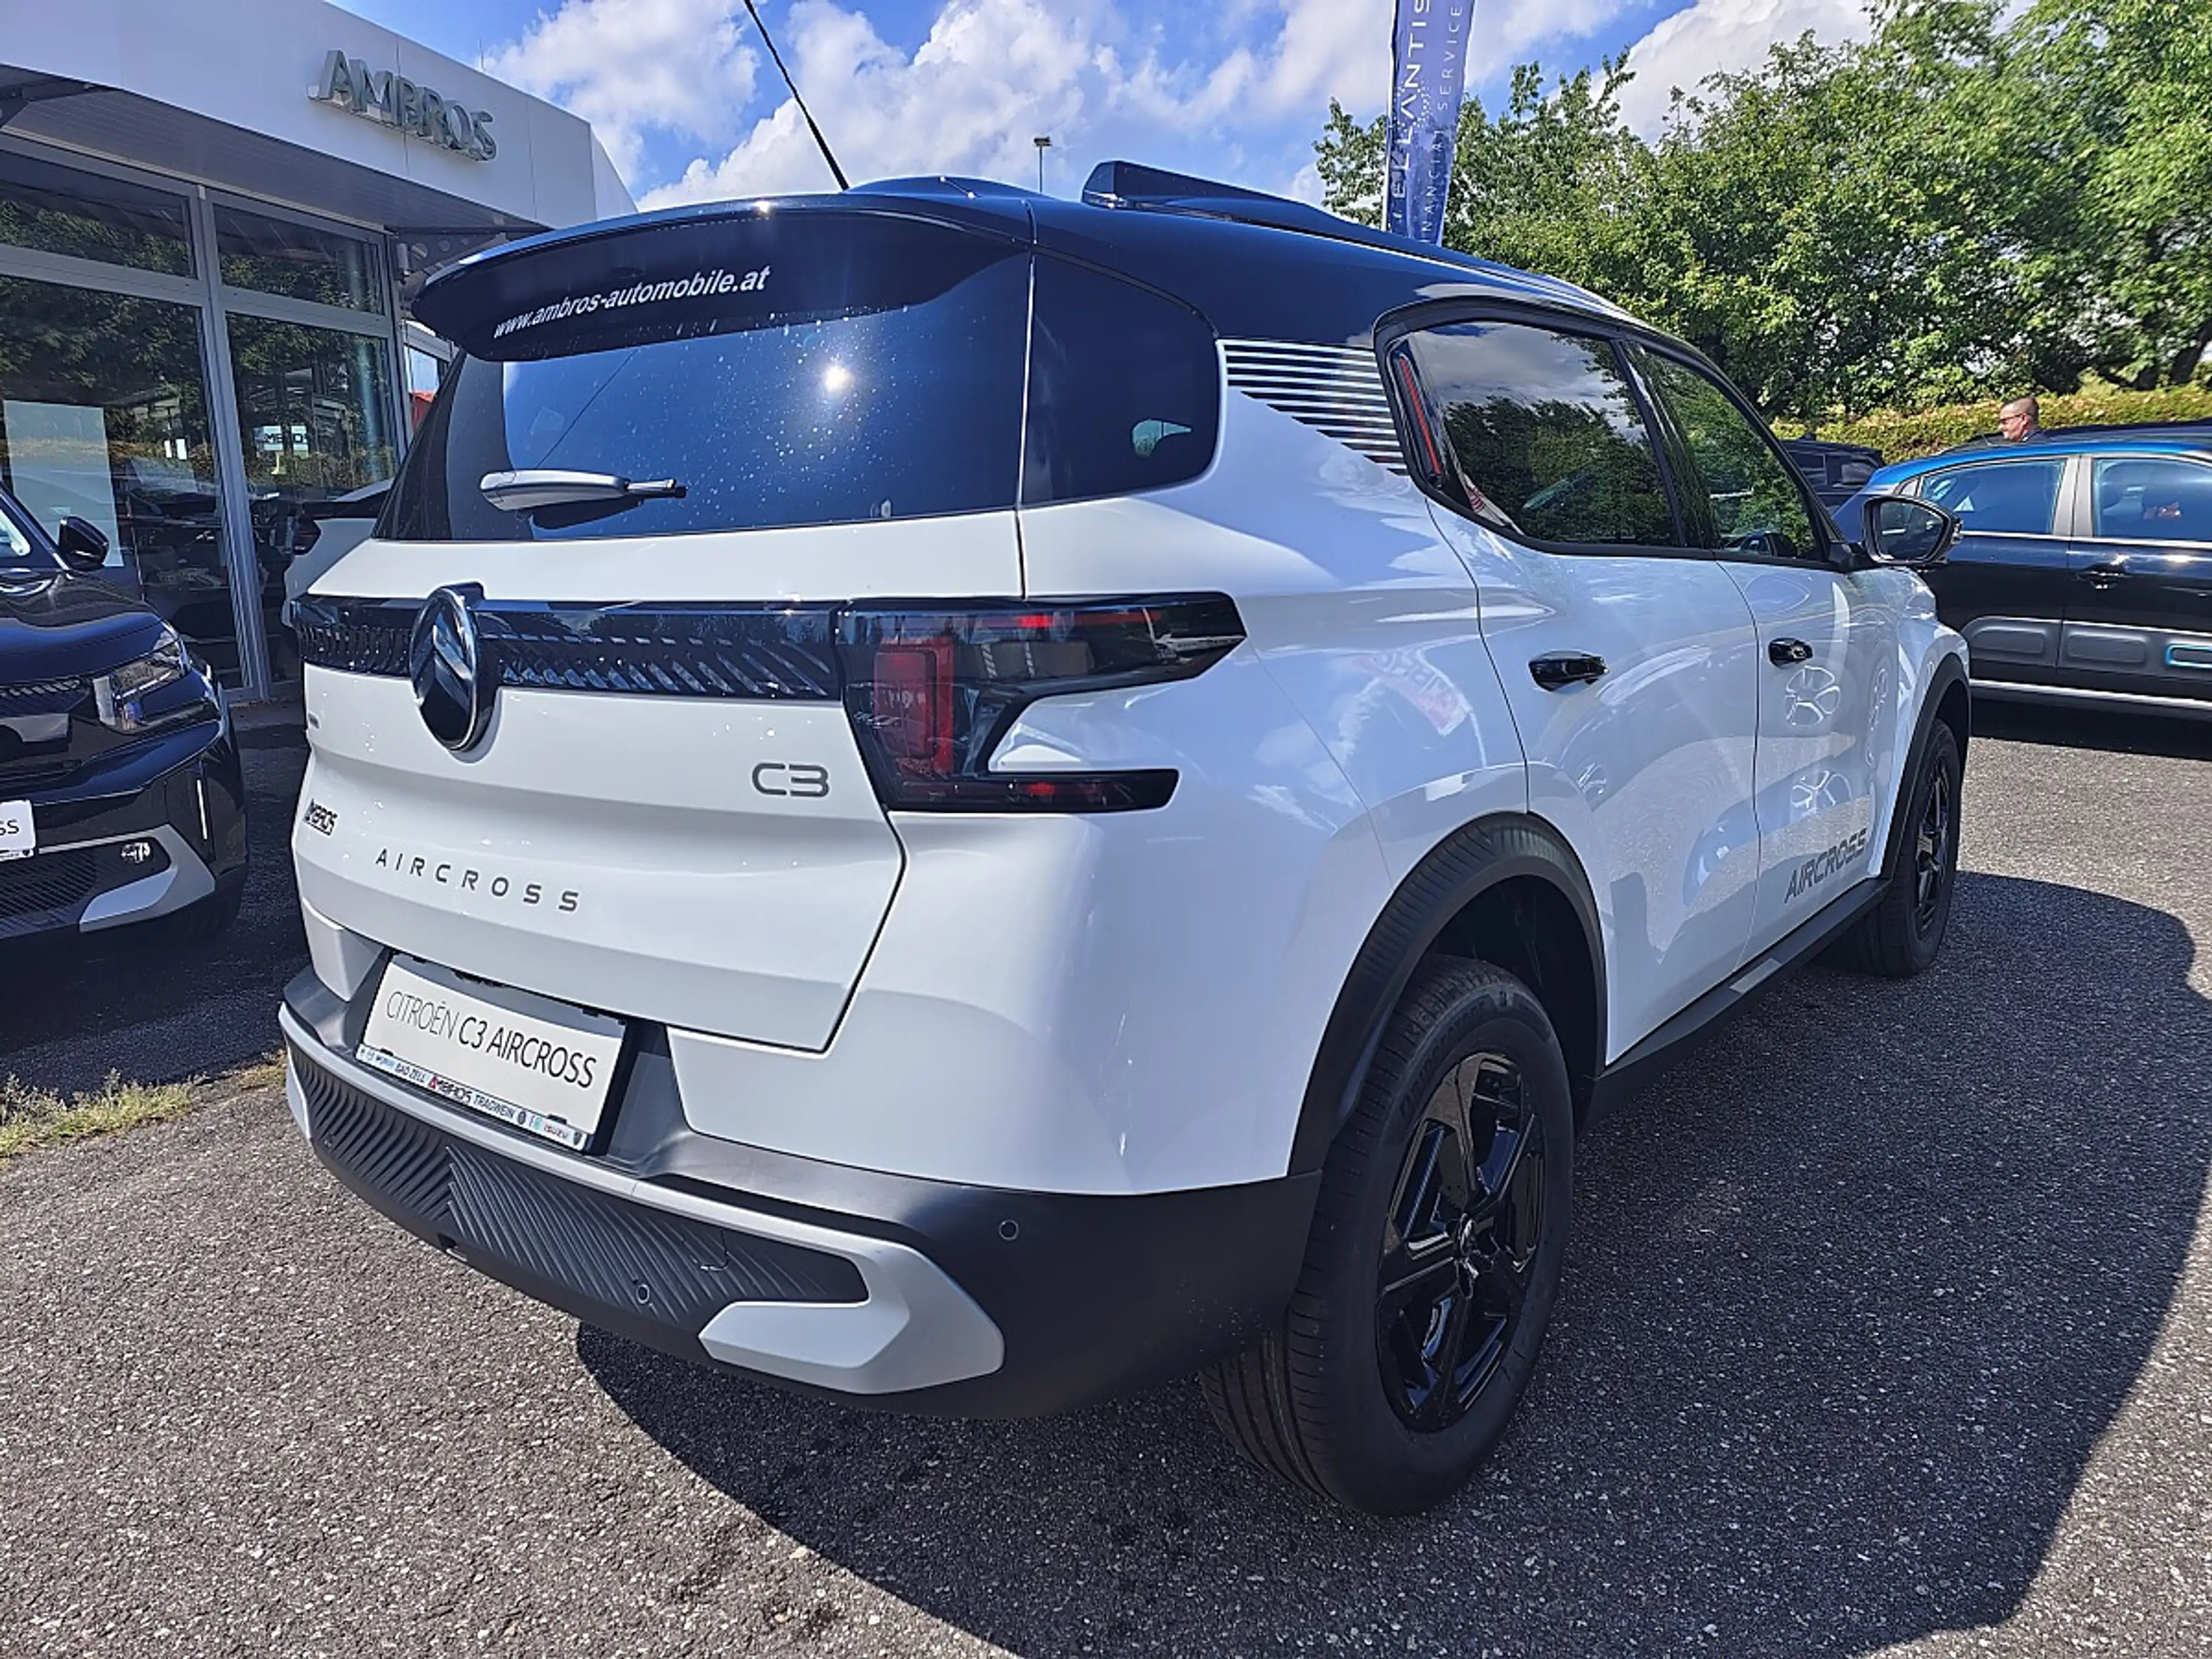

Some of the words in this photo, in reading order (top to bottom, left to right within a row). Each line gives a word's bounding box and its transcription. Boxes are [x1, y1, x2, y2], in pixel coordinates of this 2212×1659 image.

[307, 50, 498, 162] AMBROS
[1418, 130, 1445, 243] INANCIAL
[493, 266, 771, 338] www.ambros-automobile.at
[752, 763, 830, 797] C3
[376, 848, 579, 911] AIRCROSS
[1785, 827, 1867, 904] AIRCROSS
[387, 991, 460, 1039] CITROËN
[460, 1017, 487, 1048] C3
[487, 1027, 597, 1088] AIRCROSS
